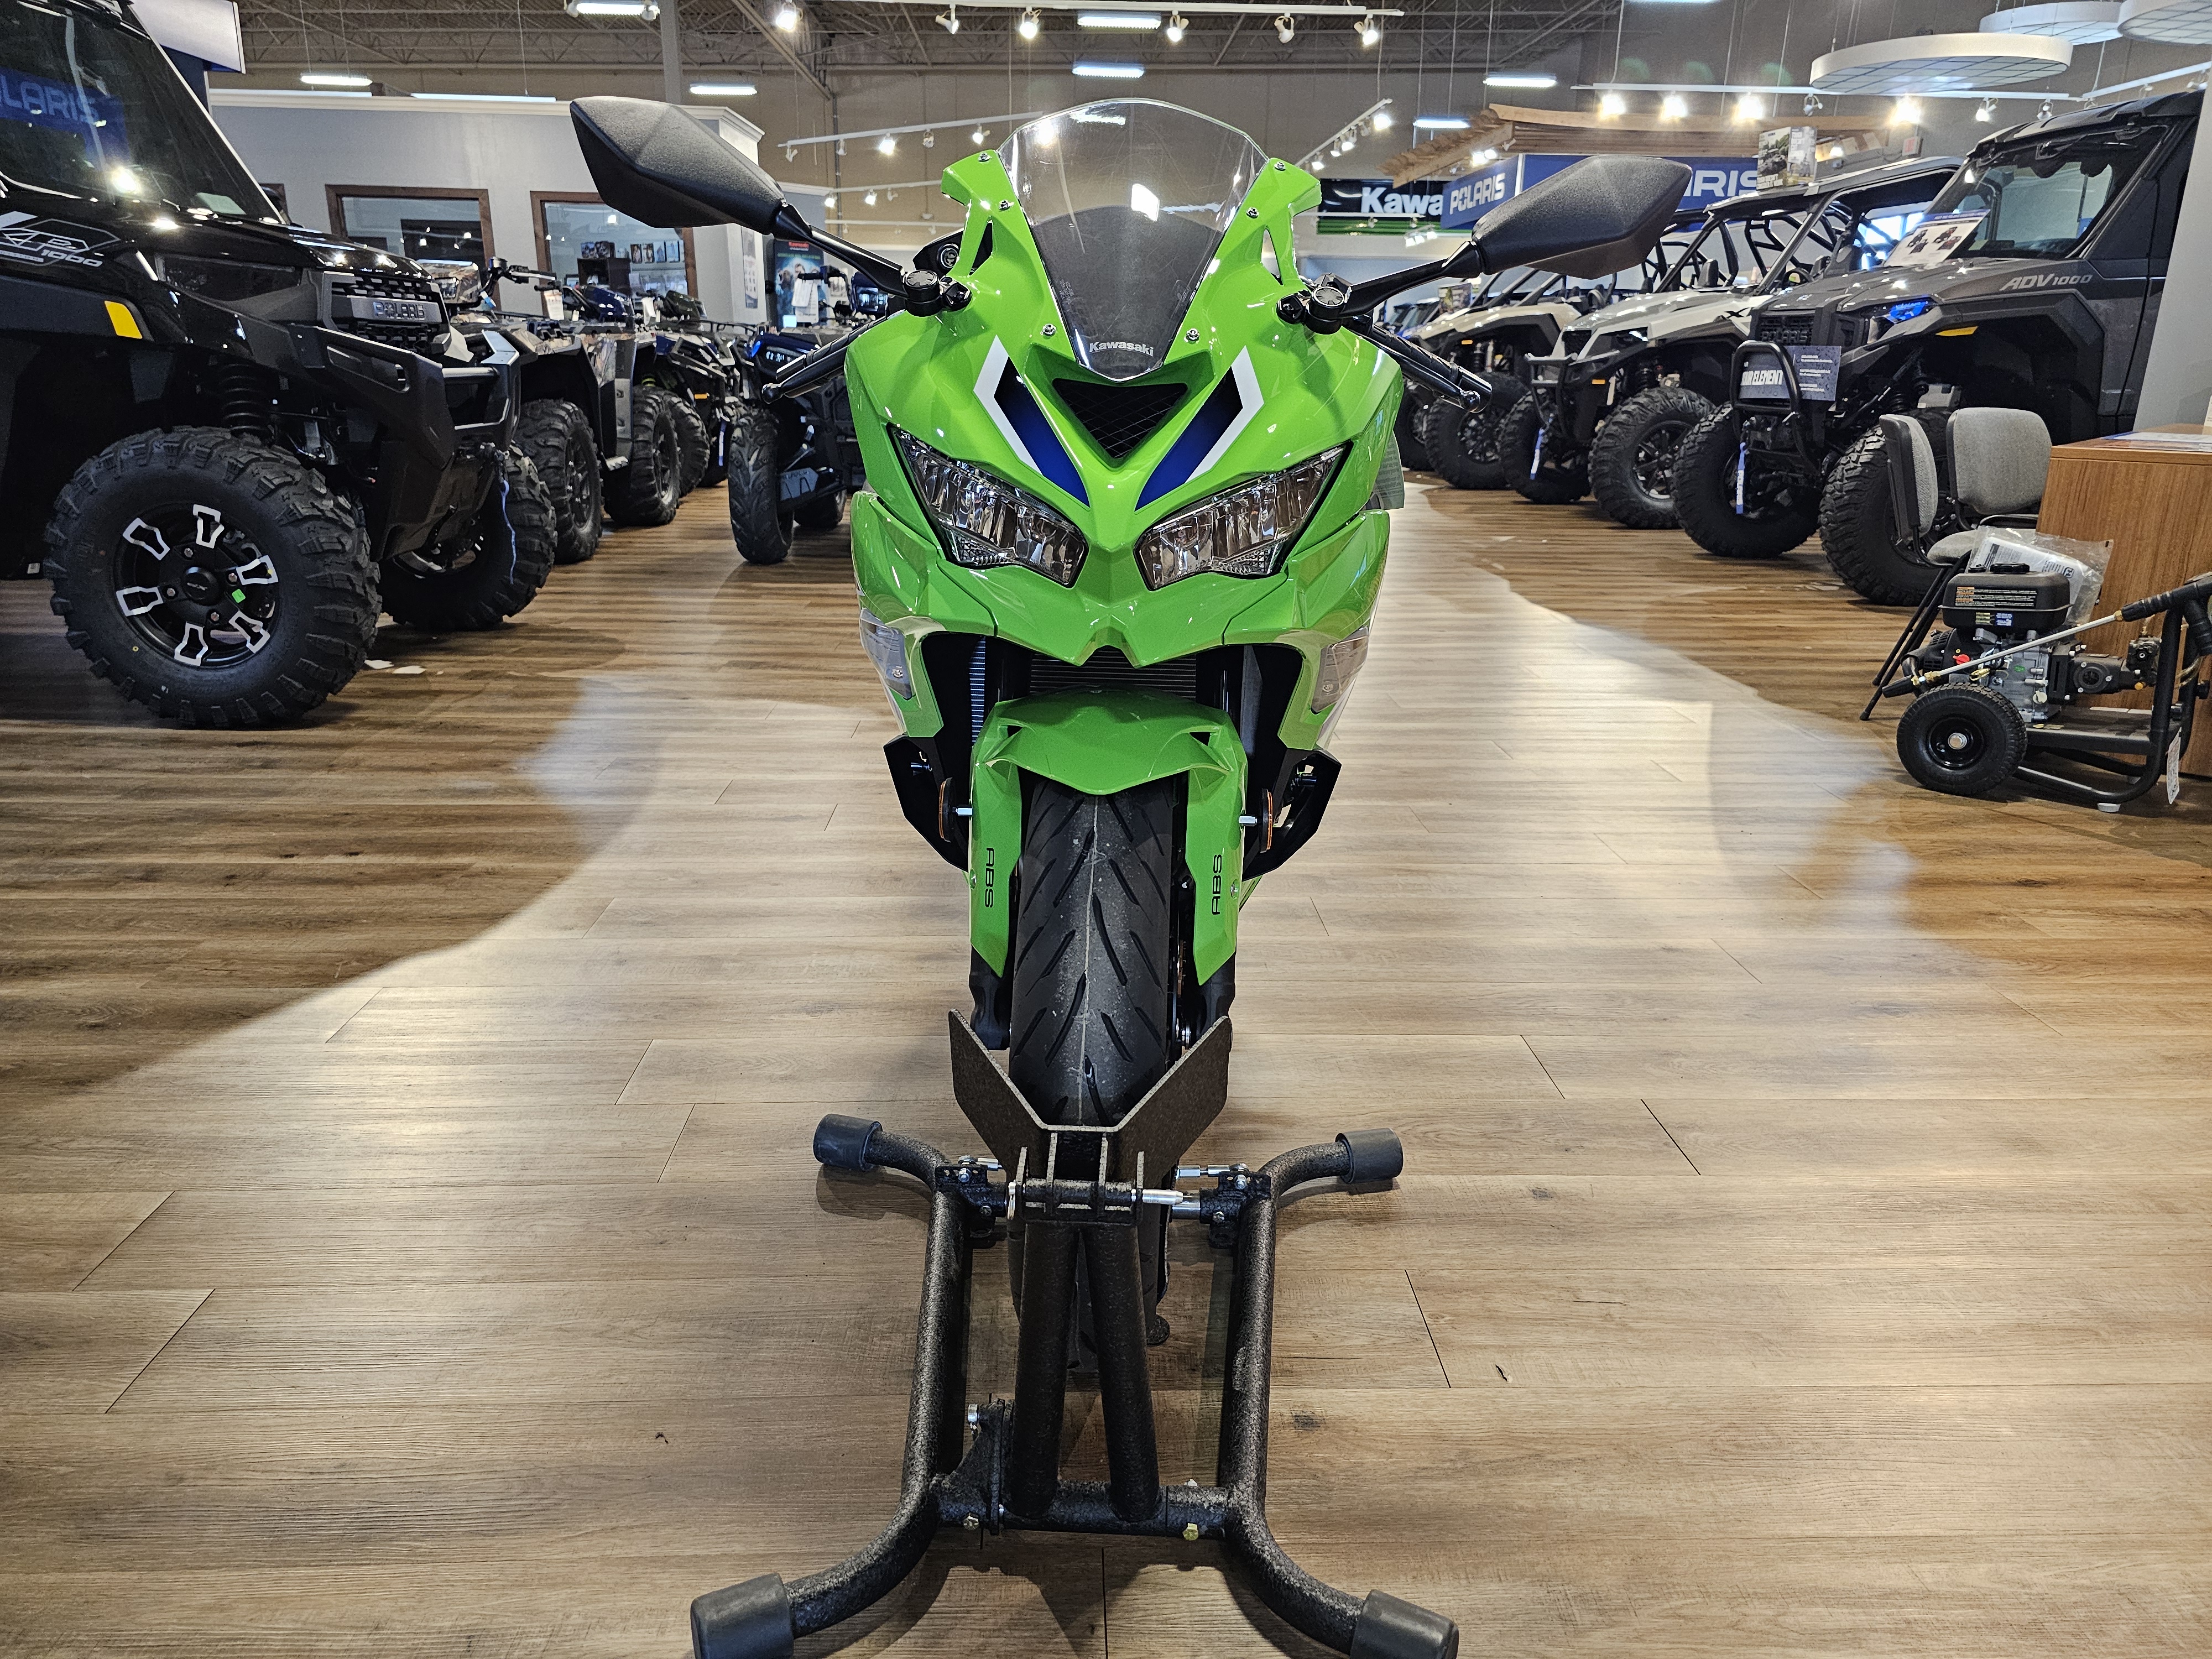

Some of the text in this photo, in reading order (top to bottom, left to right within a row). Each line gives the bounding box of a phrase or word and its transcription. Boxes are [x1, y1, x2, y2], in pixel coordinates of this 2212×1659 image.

[1683, 170, 1758, 197] RIS
[1449, 173, 1505, 215] POLARIS
[41, 249, 103, 267] 1000
[1999, 273, 2093, 291] ADV 1000
[373, 302, 425, 320] POLARIS
[1089, 341, 1154, 357] Kawasaki
[1752, 369, 1783, 385] ELEMENT
[984, 847, 995, 908] ABS
[1211, 854, 1222, 915] ABS
